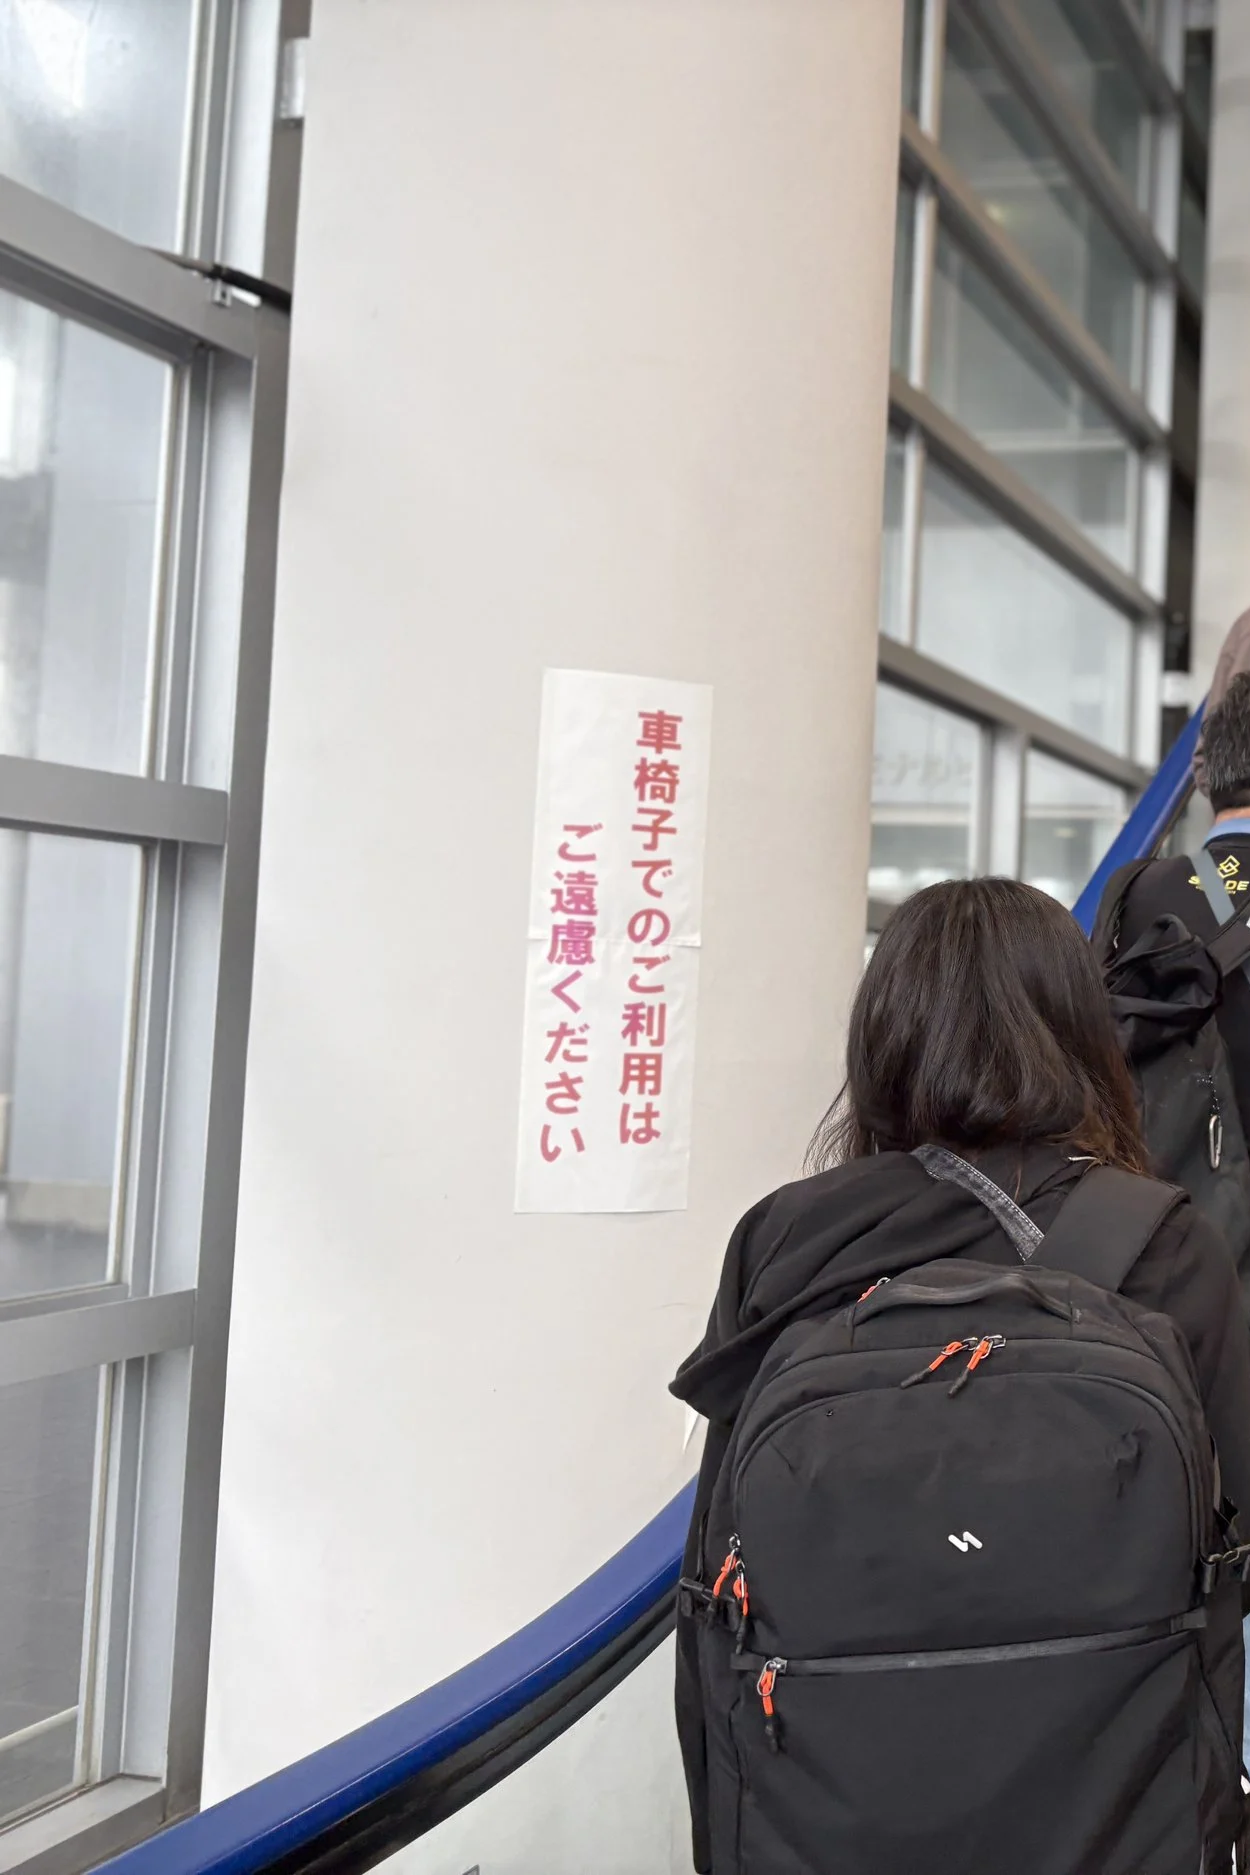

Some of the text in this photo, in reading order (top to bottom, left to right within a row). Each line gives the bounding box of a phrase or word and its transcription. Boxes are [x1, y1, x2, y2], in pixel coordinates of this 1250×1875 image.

[540, 821, 604, 1163] ご遠慮ください
[618, 709, 683, 1146] 車椅子でのご利用は
